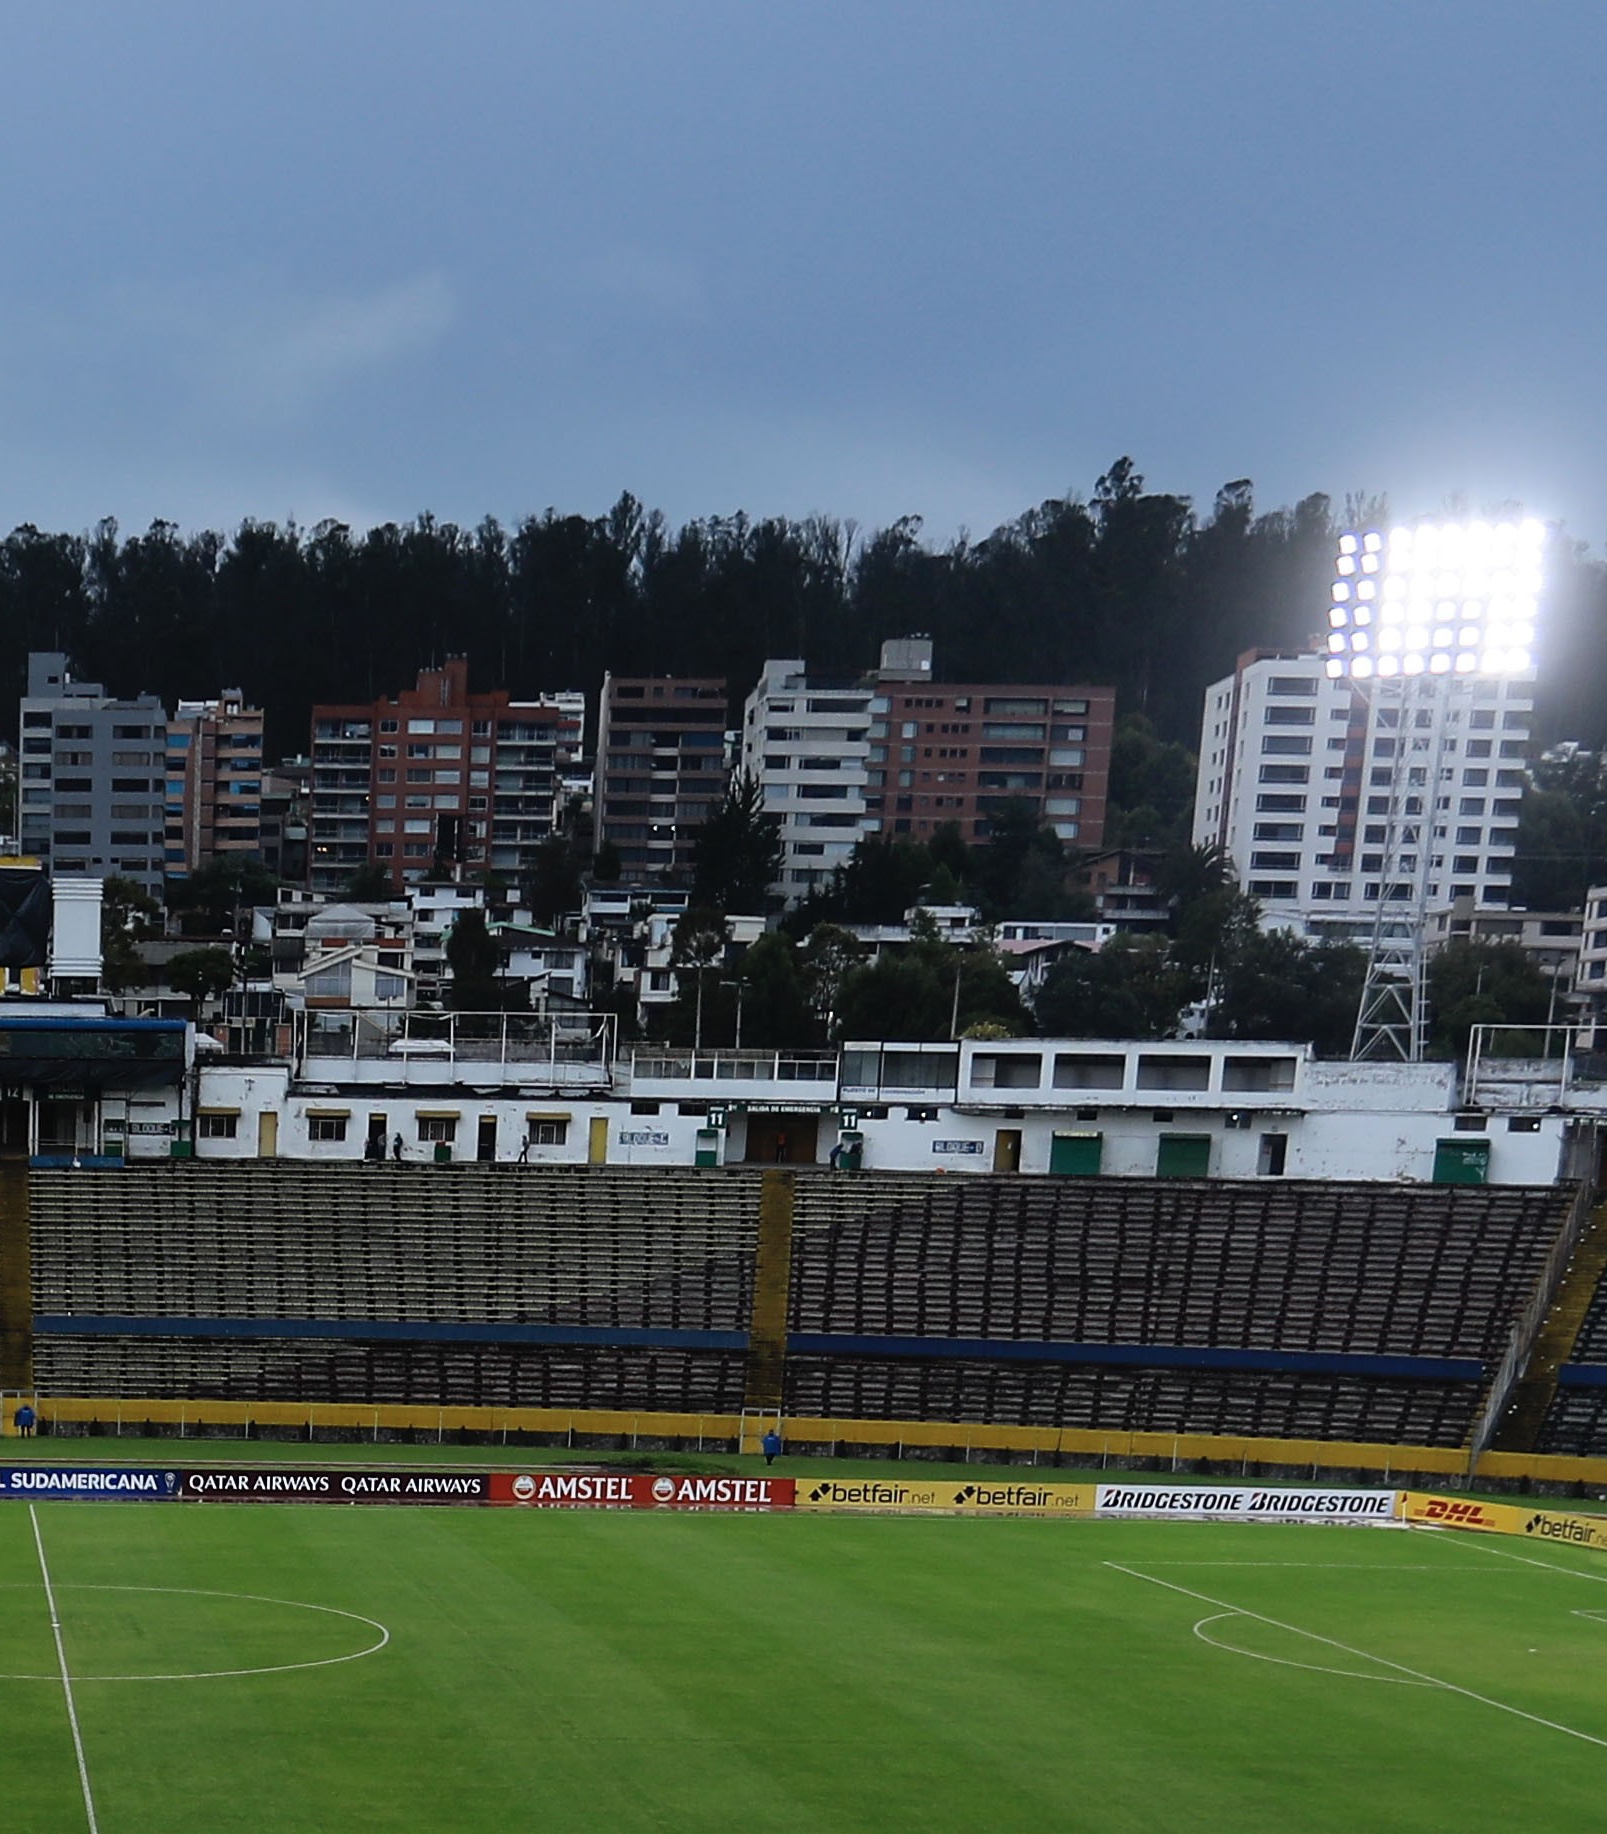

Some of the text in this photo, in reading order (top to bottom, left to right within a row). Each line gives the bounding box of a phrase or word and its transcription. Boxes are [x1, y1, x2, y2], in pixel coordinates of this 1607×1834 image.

[709, 1112, 724, 1126] 11
[842, 1114, 857, 1128] 11
[10, 1471, 158, 1491] SUDAMERICANA
[190, 1474, 329, 1493] QATAR AIRWAYS
[341, 1475, 481, 1495] QATAR AIRWAYS
[538, 1476, 632, 1501] AMSTEL
[677, 1478, 771, 1503] AMSTEL
[832, 1482, 935, 1504] betfair.net
[976, 1485, 1079, 1509] betfair.net
[1103, 1489, 1242, 1511] BRIDGESTONE
[1248, 1492, 1388, 1514] BRIDGESTONE
[1425, 1499, 1484, 1525] DHL
